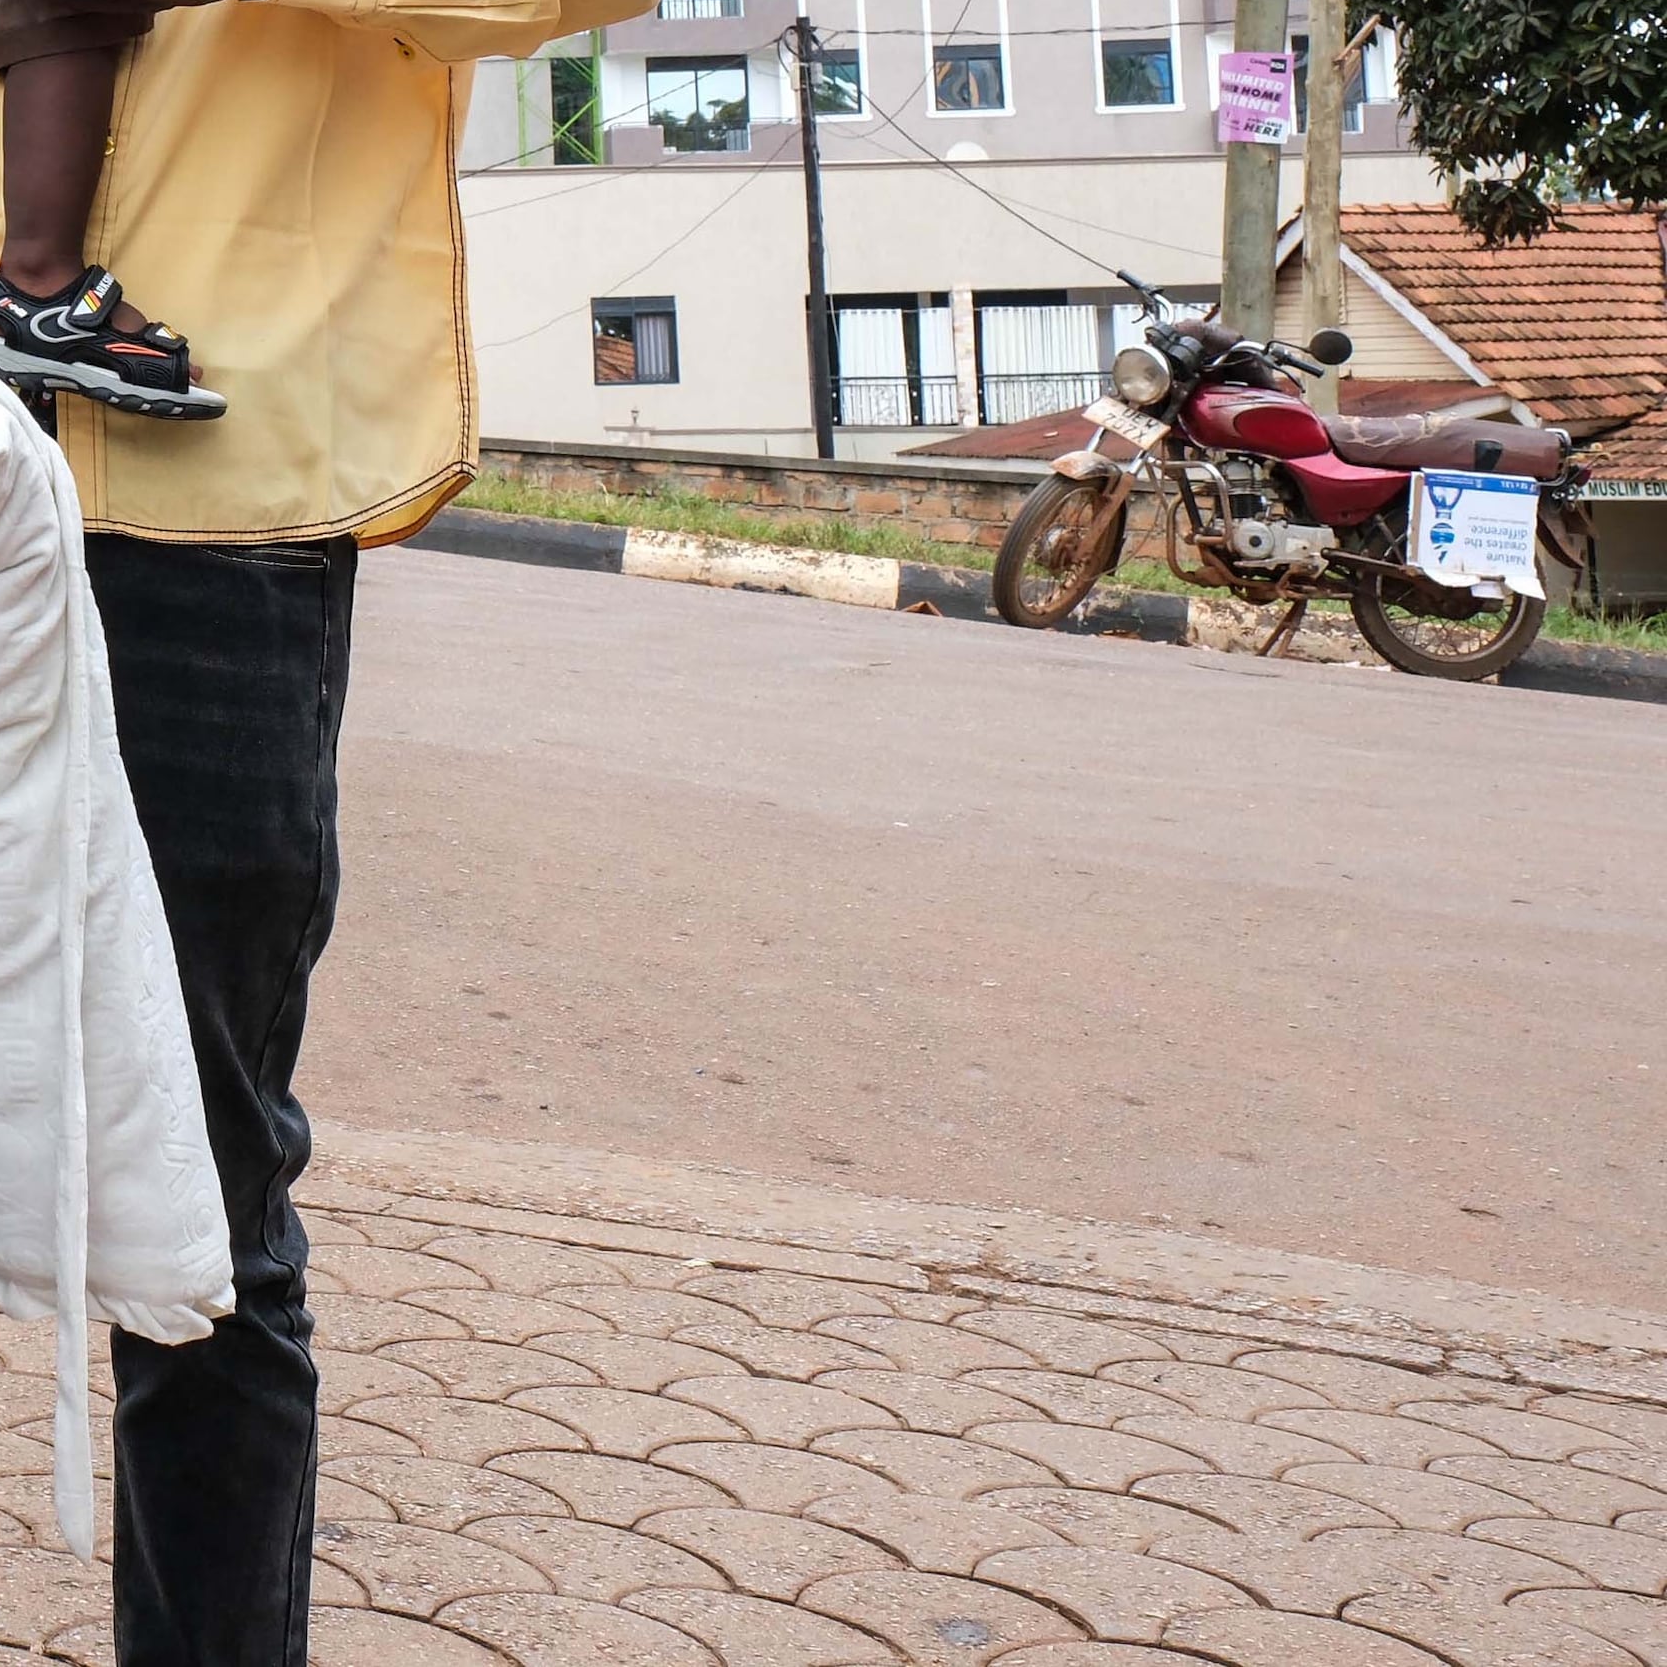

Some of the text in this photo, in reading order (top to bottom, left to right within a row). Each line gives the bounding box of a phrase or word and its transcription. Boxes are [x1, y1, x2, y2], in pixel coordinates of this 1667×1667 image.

[1241, 86, 1282, 102] HOME
[1243, 122, 1282, 138] HERE
[1588, 481, 1641, 497] MUSLIM
[1464, 537, 1527, 550] creates the
[1486, 552, 1527, 566] Nature
